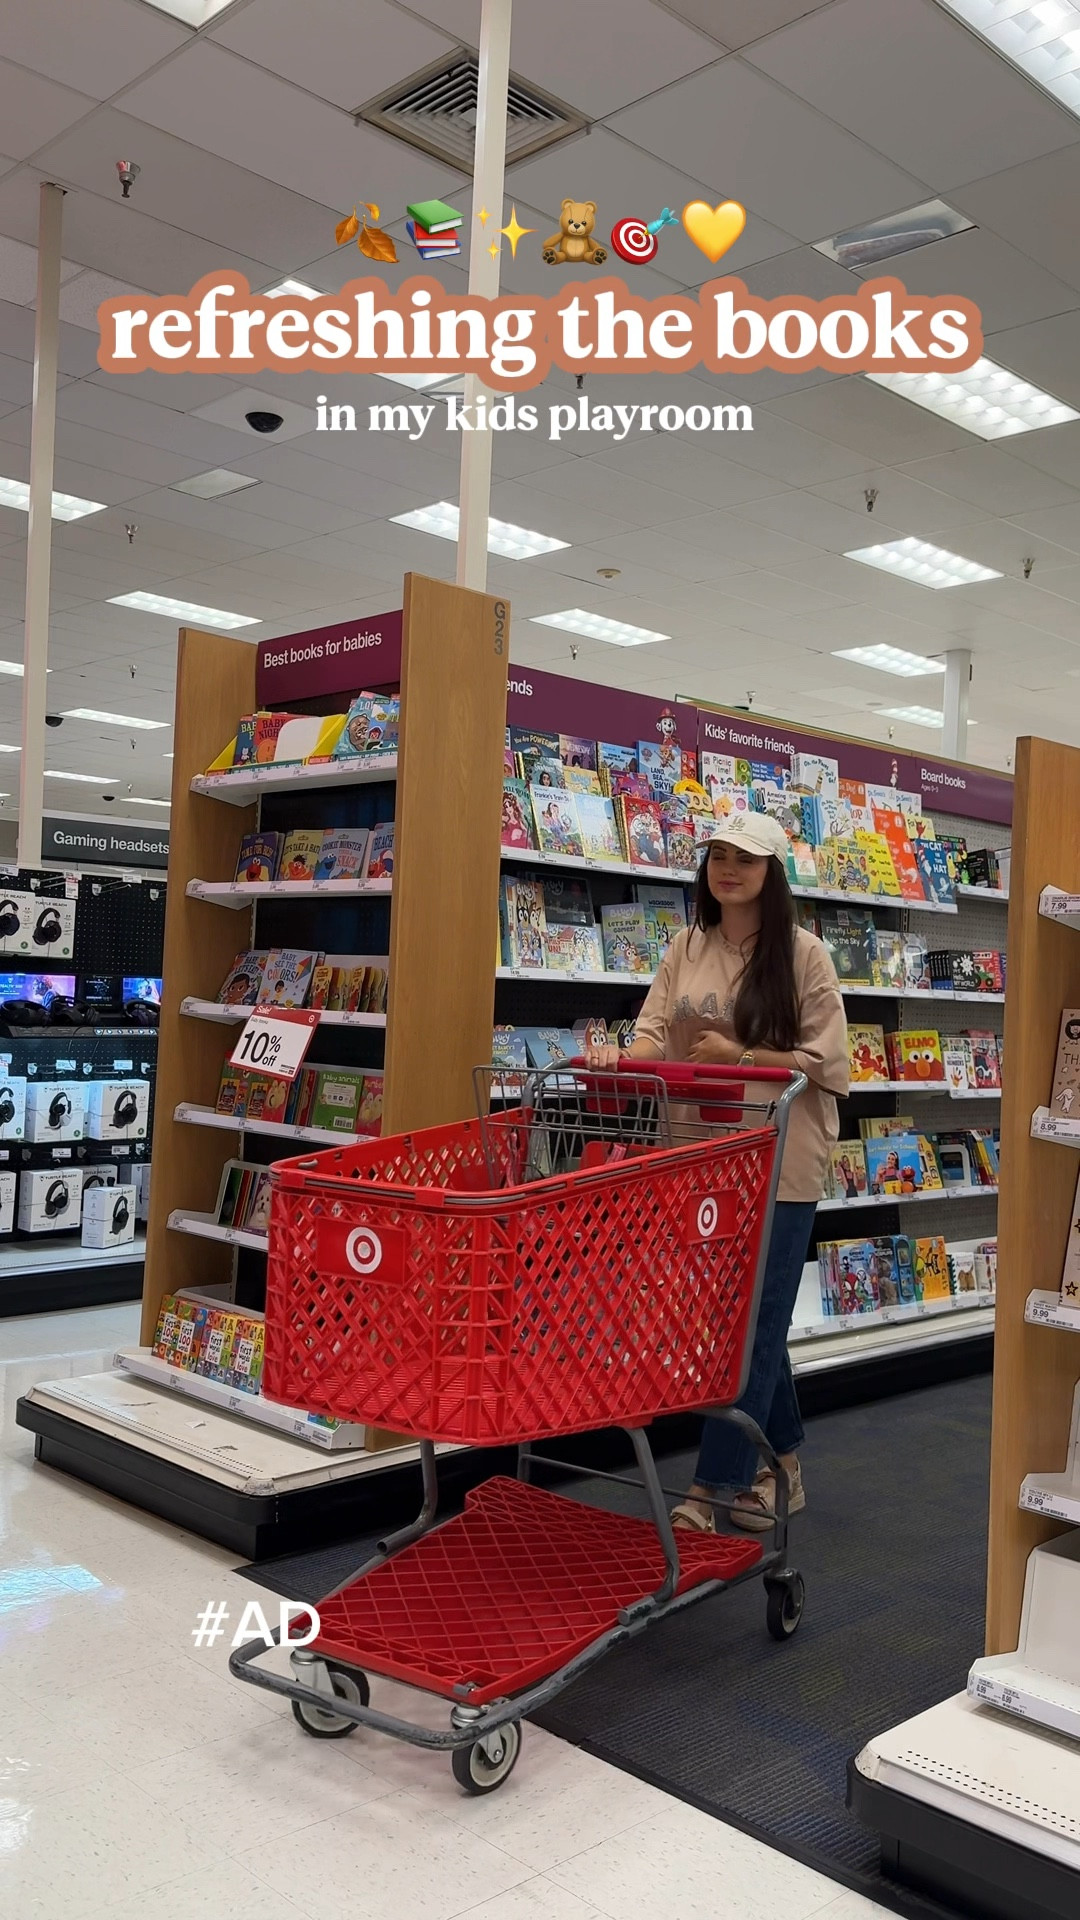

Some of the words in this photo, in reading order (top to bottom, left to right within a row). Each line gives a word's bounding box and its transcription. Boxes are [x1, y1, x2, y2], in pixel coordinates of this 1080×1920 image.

[264, 650, 289, 668] Best
[290, 644, 323, 663] books
[325, 640, 341, 656] for
[343, 631, 382, 652] babies
[705, 723, 728, 741] Kids'
[729, 728, 763, 749] favorite
[764, 737, 795, 755] friends
[713, 756, 731, 766] Picnic
[716, 765, 731, 774] Time!
[921, 768, 942, 786] Board
[944, 774, 966, 790] books
[654, 781, 671, 791] SKY!
[921, 783, 931, 791] Ages
[767, 792, 786, 800] Amazing
[53, 831, 107, 851] Gaming
[110, 836, 169, 854] headsets
[338, 840, 362, 852] MONSTER
[929, 842, 942, 851] CAT
[933, 864, 947, 874] HAT
[826, 926, 845, 936] Firefly
[846, 927, 862, 936] Light
[850, 938, 860, 947] Sky
[267, 967, 300, 983] COLORS!
[256, 1005, 272, 1015] Sale!
[240, 1030, 282, 1064] 10%
[904, 1037, 936, 1049] ELMO
[262, 1055, 277, 1067] off
[1064, 1053, 1080, 1065] TH
[322, 1073, 337, 1083] Baby
[338, 1076, 360, 1084] animals
[1041, 1123, 1056, 1131] 8.99
[1033, 1309, 1049, 1317] 9.99
[163, 1326, 174, 1337] 100
[181, 1325, 193, 1335] first
[179, 1335, 191, 1346] 100
[211, 1335, 222, 1346] first
[240, 1344, 252, 1356] first
[207, 1353, 218, 1362] love
[236, 1363, 247, 1373] love
[1028, 1495, 1043, 1505] 9.99
